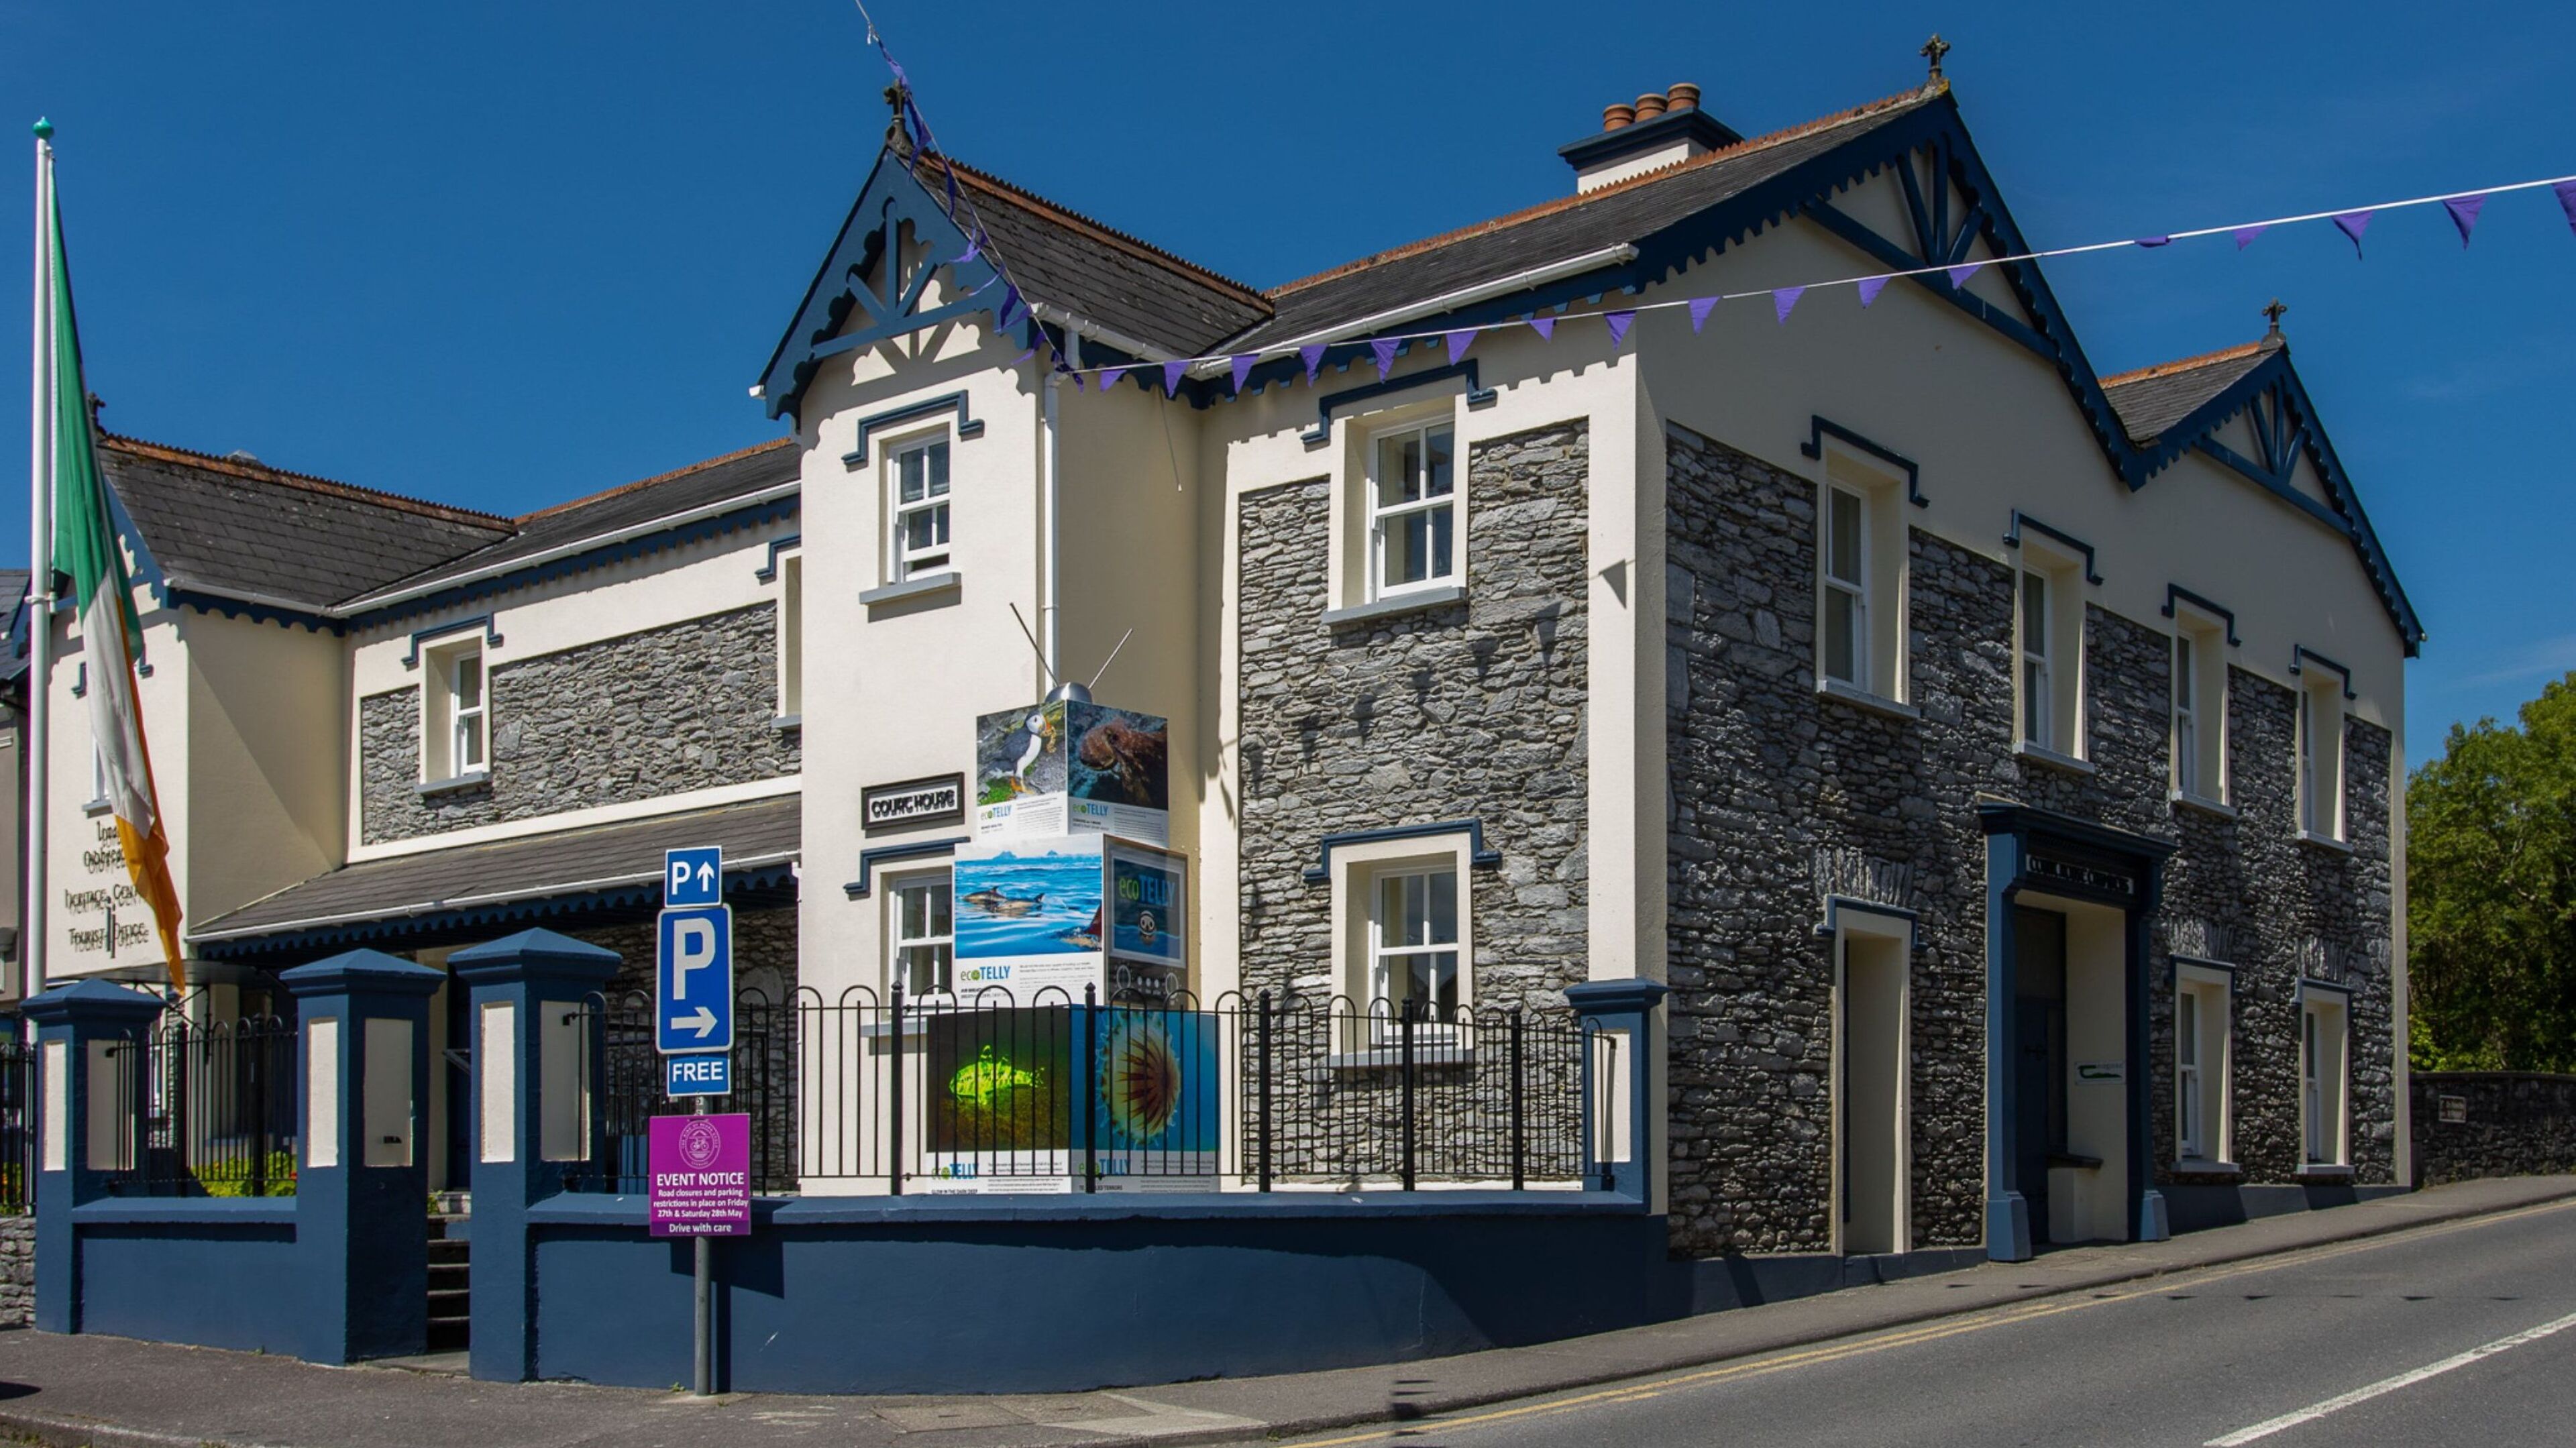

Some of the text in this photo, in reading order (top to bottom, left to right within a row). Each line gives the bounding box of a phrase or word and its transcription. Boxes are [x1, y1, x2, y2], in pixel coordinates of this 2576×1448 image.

[871, 789, 955, 817] COURT HOUSE
[672, 861, 691, 895] P
[1118, 875, 1175, 907] ecoTELLY
[673, 917, 716, 1000] P
[961, 966, 1010, 981] ecoTELLY
[673, 1062, 723, 1082] FREE
[657, 1172, 745, 1186] EVENT NOTICE
[718, 1188, 743, 1197] parking
[653, 1199, 690, 1207] restrictions
[698, 1199, 716, 1208] place
[727, 1199, 749, 1208] Friday
[657, 1209, 673, 1217] 27th
[681, 1209, 710, 1218] Saturday
[728, 1209, 743, 1219] May
[669, 1223, 691, 1233] Drive
[692, 1223, 712, 1232] with
